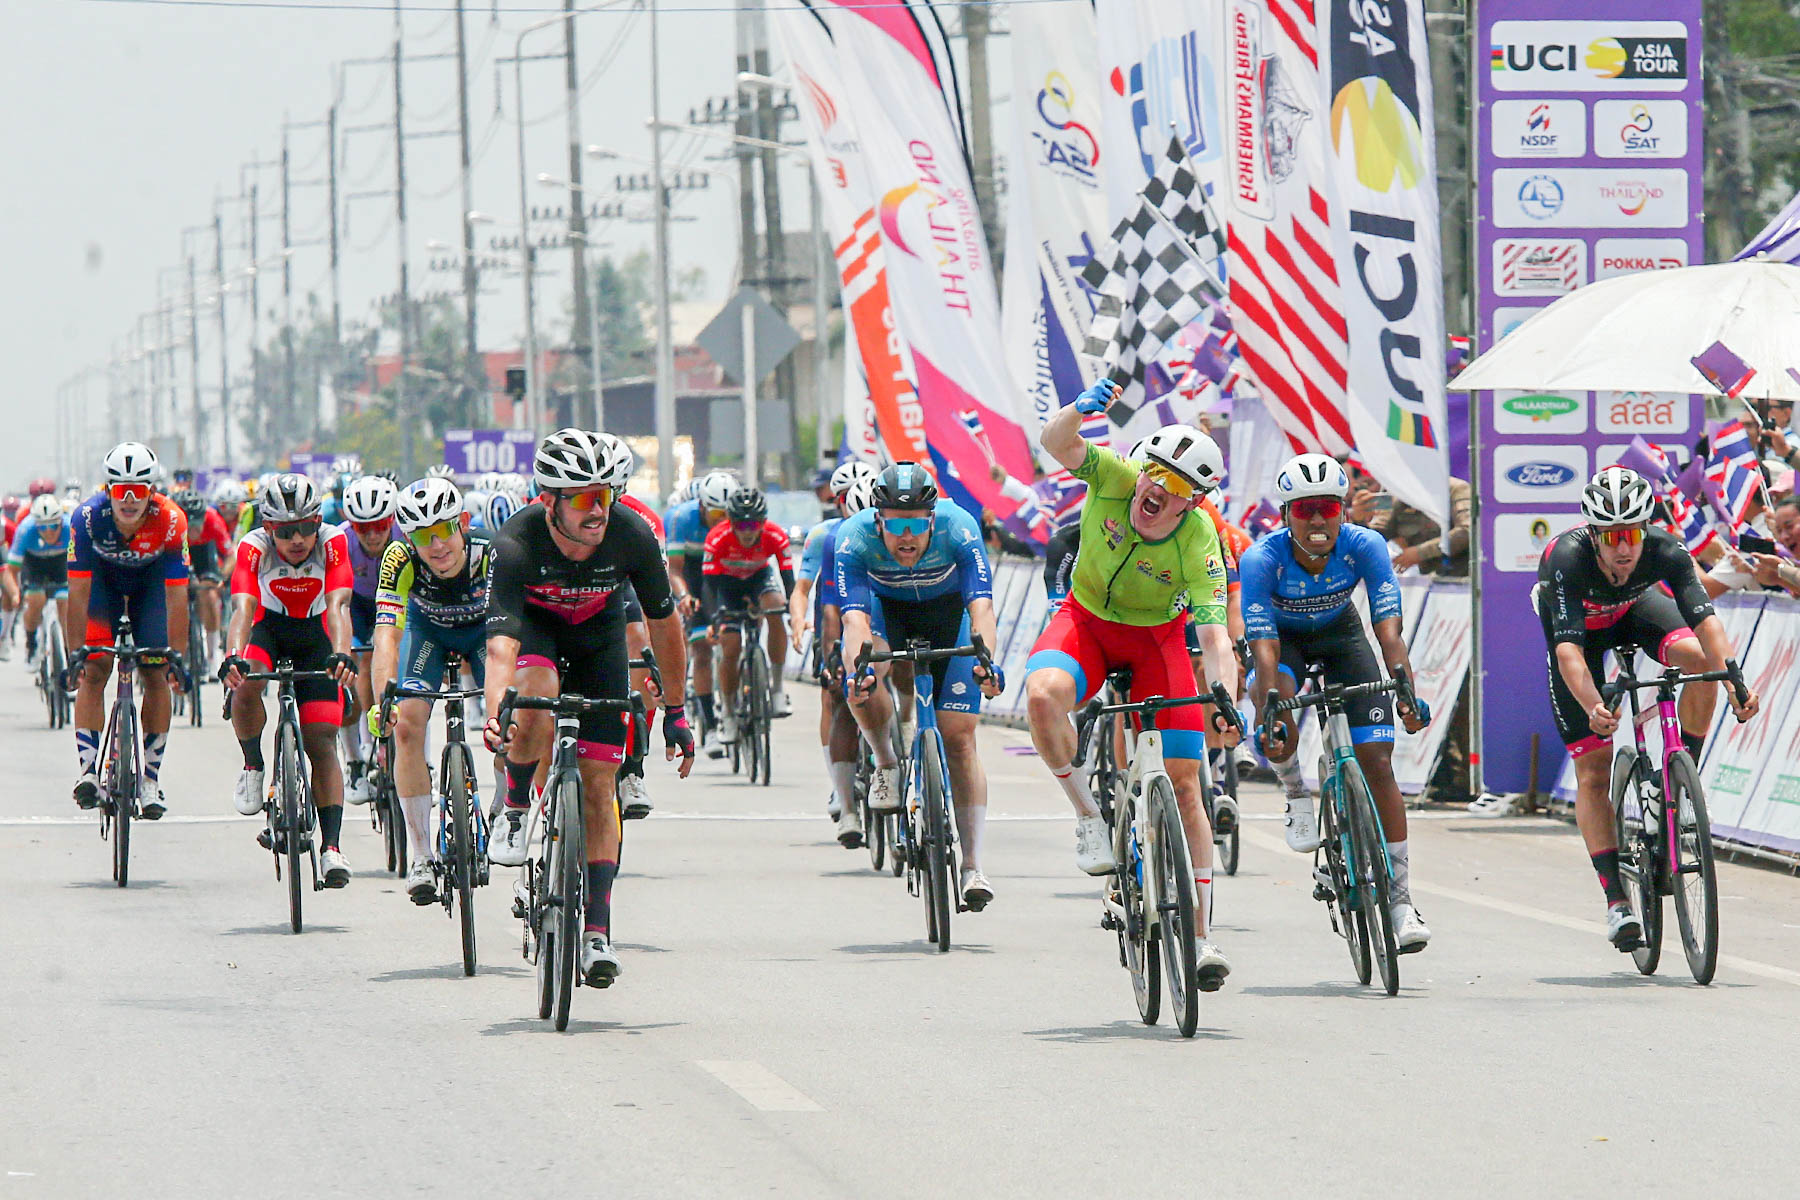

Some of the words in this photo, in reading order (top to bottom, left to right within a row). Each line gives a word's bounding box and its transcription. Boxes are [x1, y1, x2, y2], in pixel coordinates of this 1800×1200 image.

[1506, 44, 1577, 72] UCI
[1633, 44, 1672, 59] ASIA
[1633, 59, 1679, 73] TOUR
[1520, 135, 1558, 147] NSDF
[1624, 135, 1660, 149] SAT
[1600, 187, 1664, 199] THAILAND
[1603, 257, 1655, 269] POKKA
[462, 440, 516, 473] 100
[1518, 465, 1563, 485] Ford
[1055, 552, 1074, 595] SHIMANO
